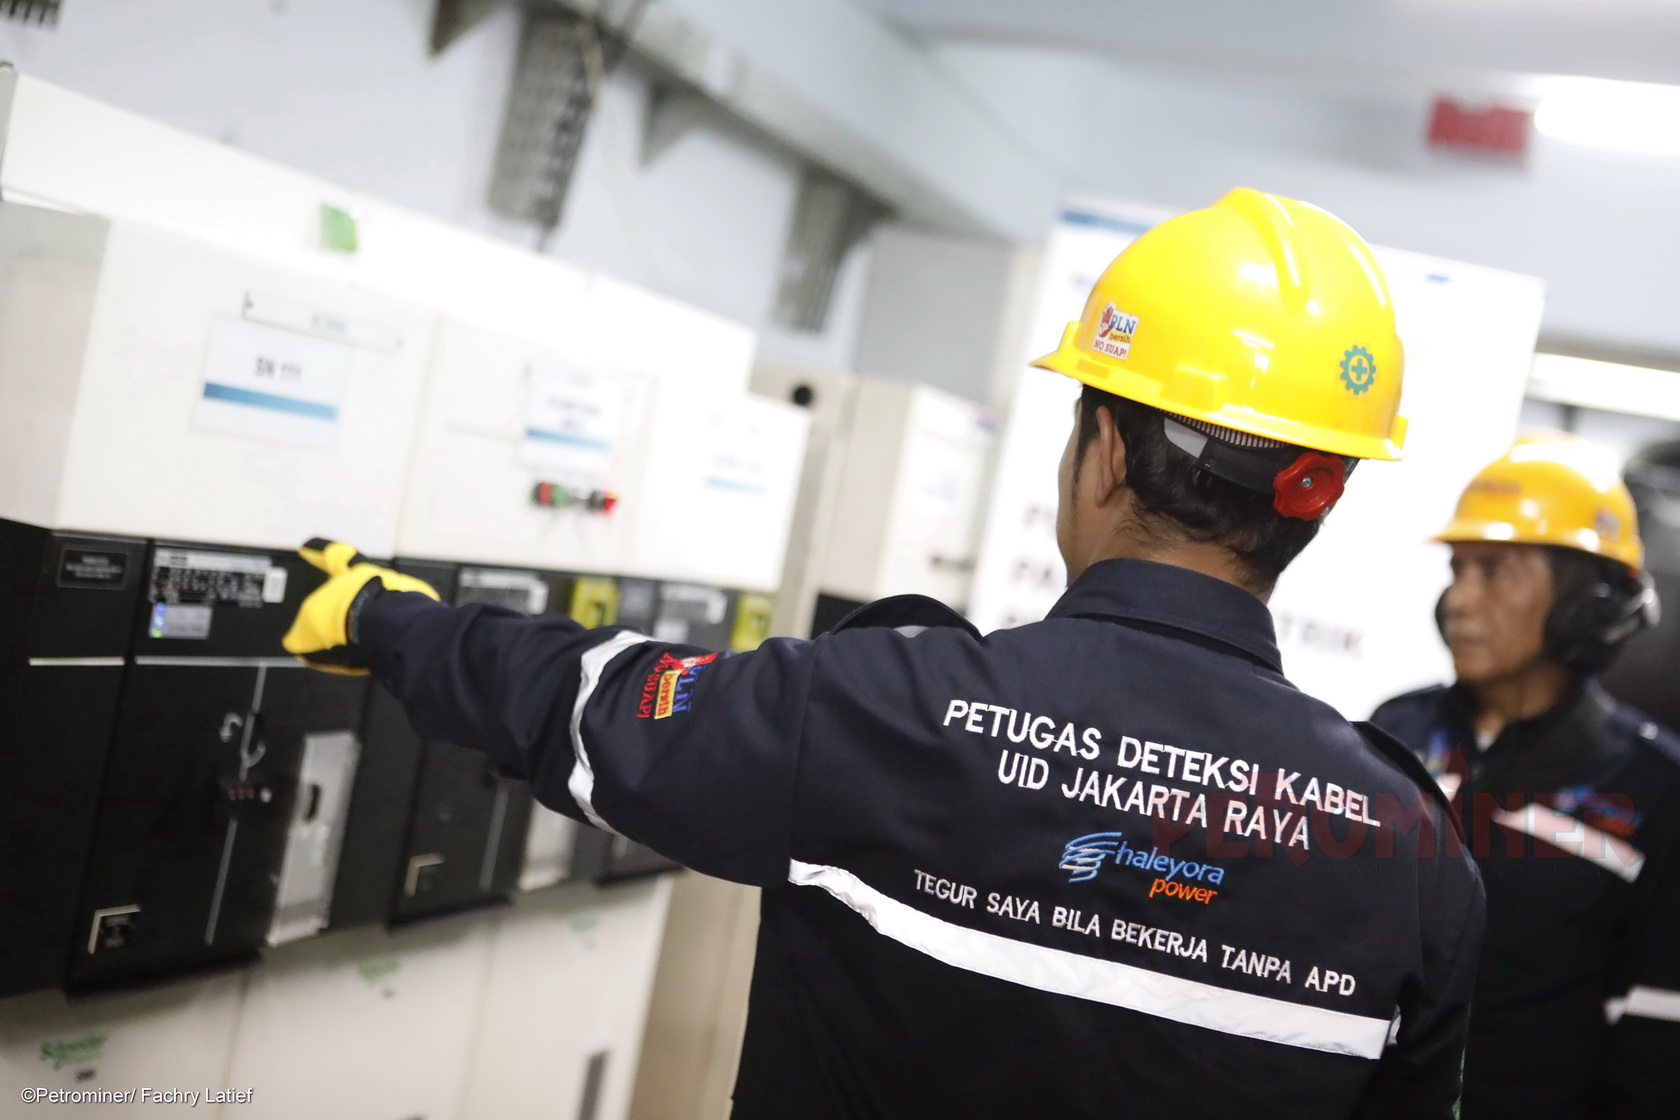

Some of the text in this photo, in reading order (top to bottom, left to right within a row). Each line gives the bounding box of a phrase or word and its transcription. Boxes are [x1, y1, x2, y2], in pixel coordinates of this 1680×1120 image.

[1093, 339, 1105, 350] NO
[1109, 314, 1136, 334] PLN
[943, 699, 1381, 828] PETUGAS DETEKSI KABEL
[997, 750, 1310, 851] UID JAKARTA RAYA
[1115, 841, 1225, 885] haleyora
[1148, 878, 1218, 905] power
[914, 869, 1356, 997] TEGUR SAYA BILA BEKERJA TANPA APD
